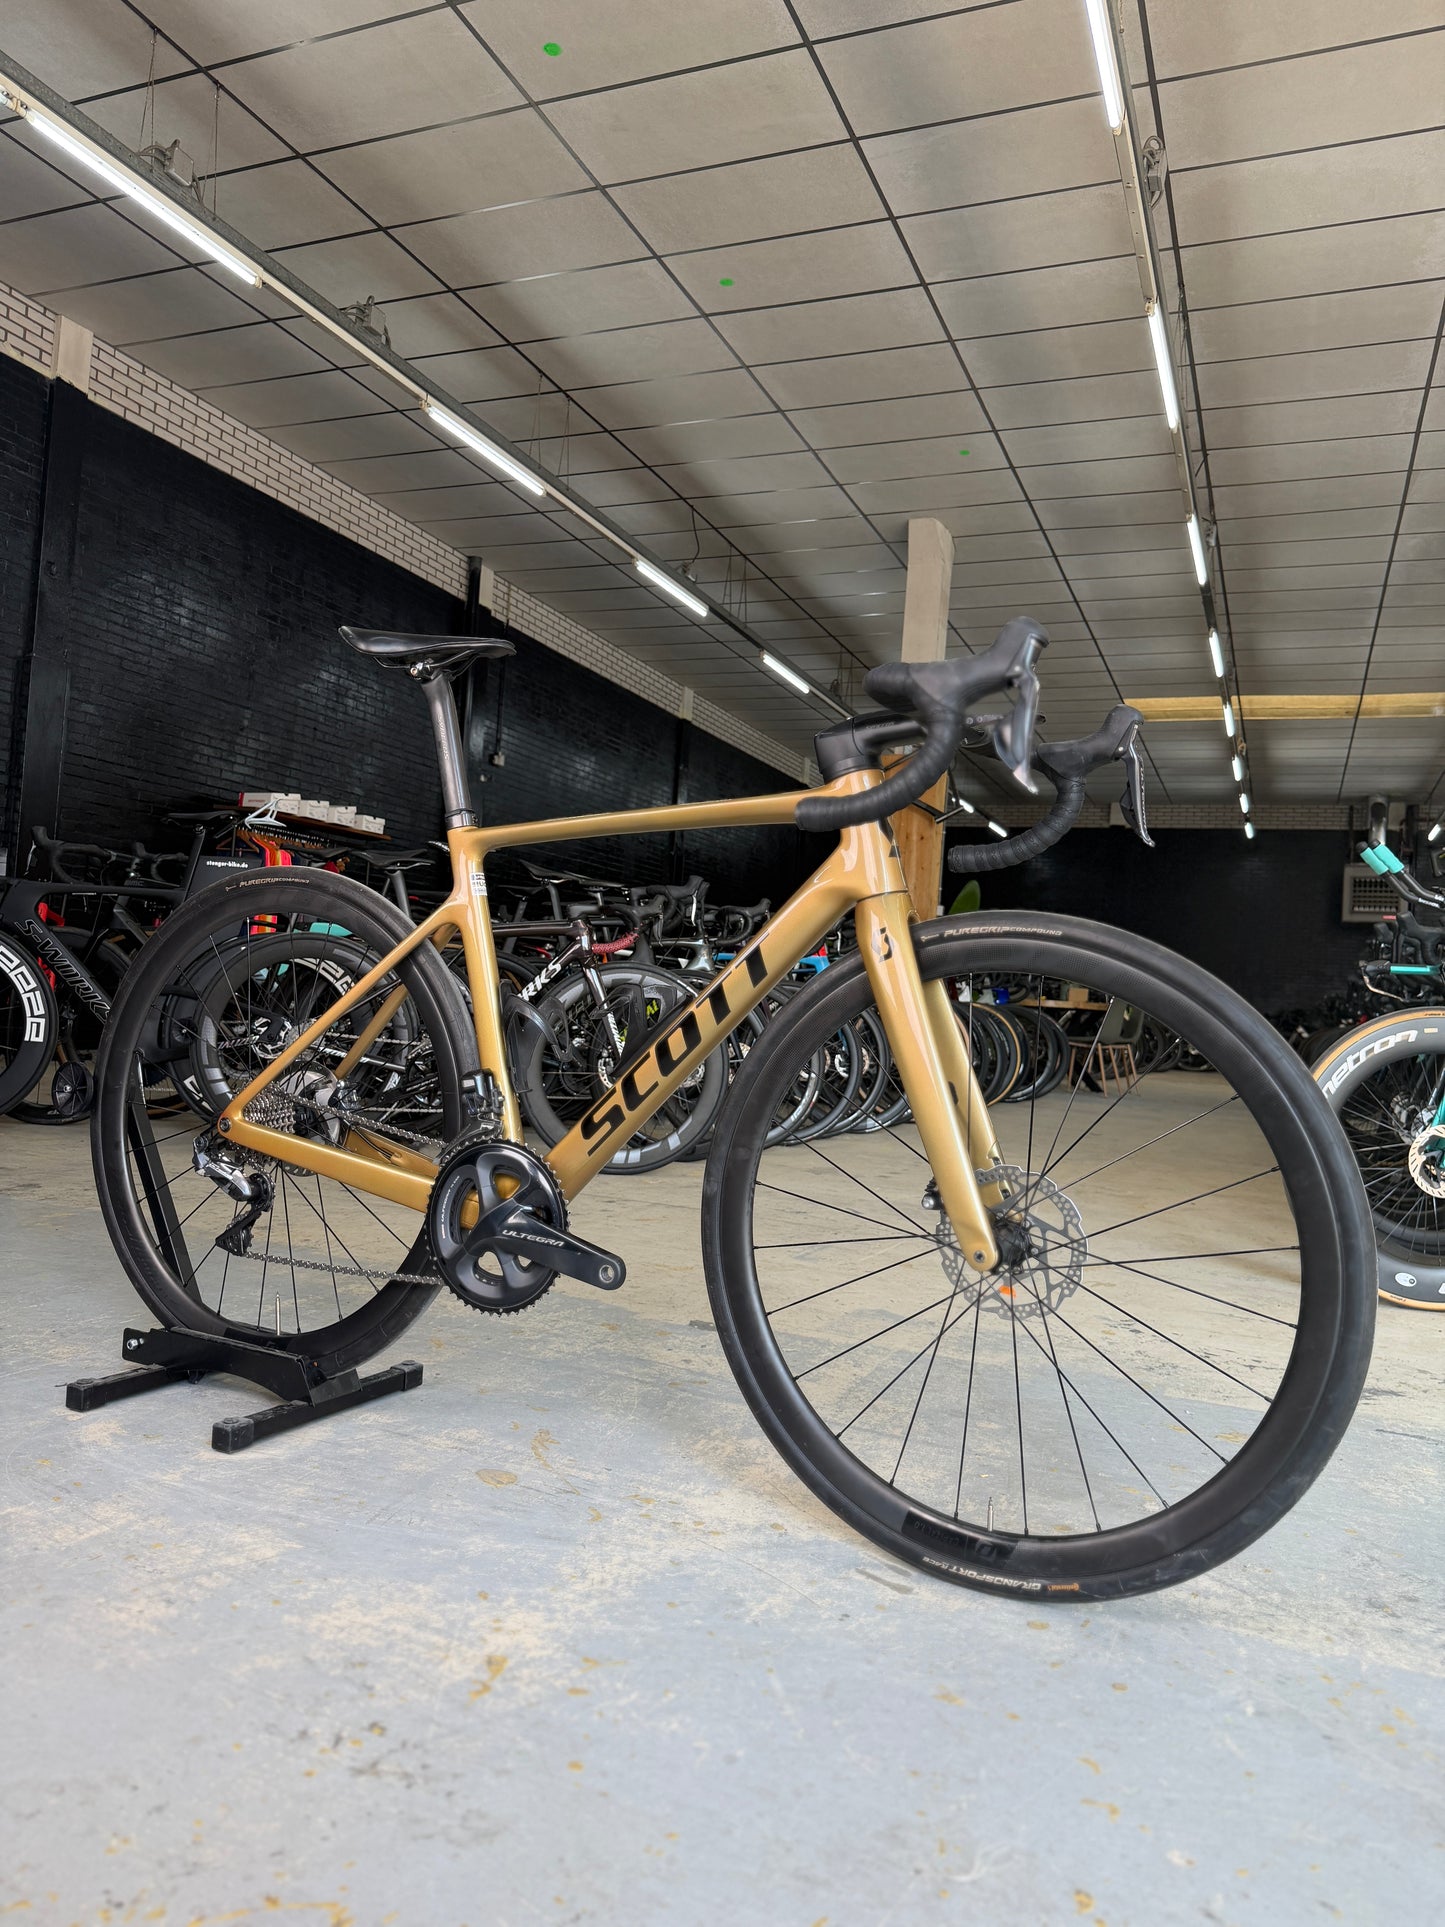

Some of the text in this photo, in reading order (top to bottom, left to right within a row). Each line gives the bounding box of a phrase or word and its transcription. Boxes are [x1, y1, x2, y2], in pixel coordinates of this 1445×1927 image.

[517, 956, 562, 1002] RKS
[581, 931, 769, 1157] SCOTT
[502, 1229, 565, 1247] ULTEGRA
[922, 1555, 950, 1570] RACE
[948, 1565, 1042, 1591] GRANDSPORT
